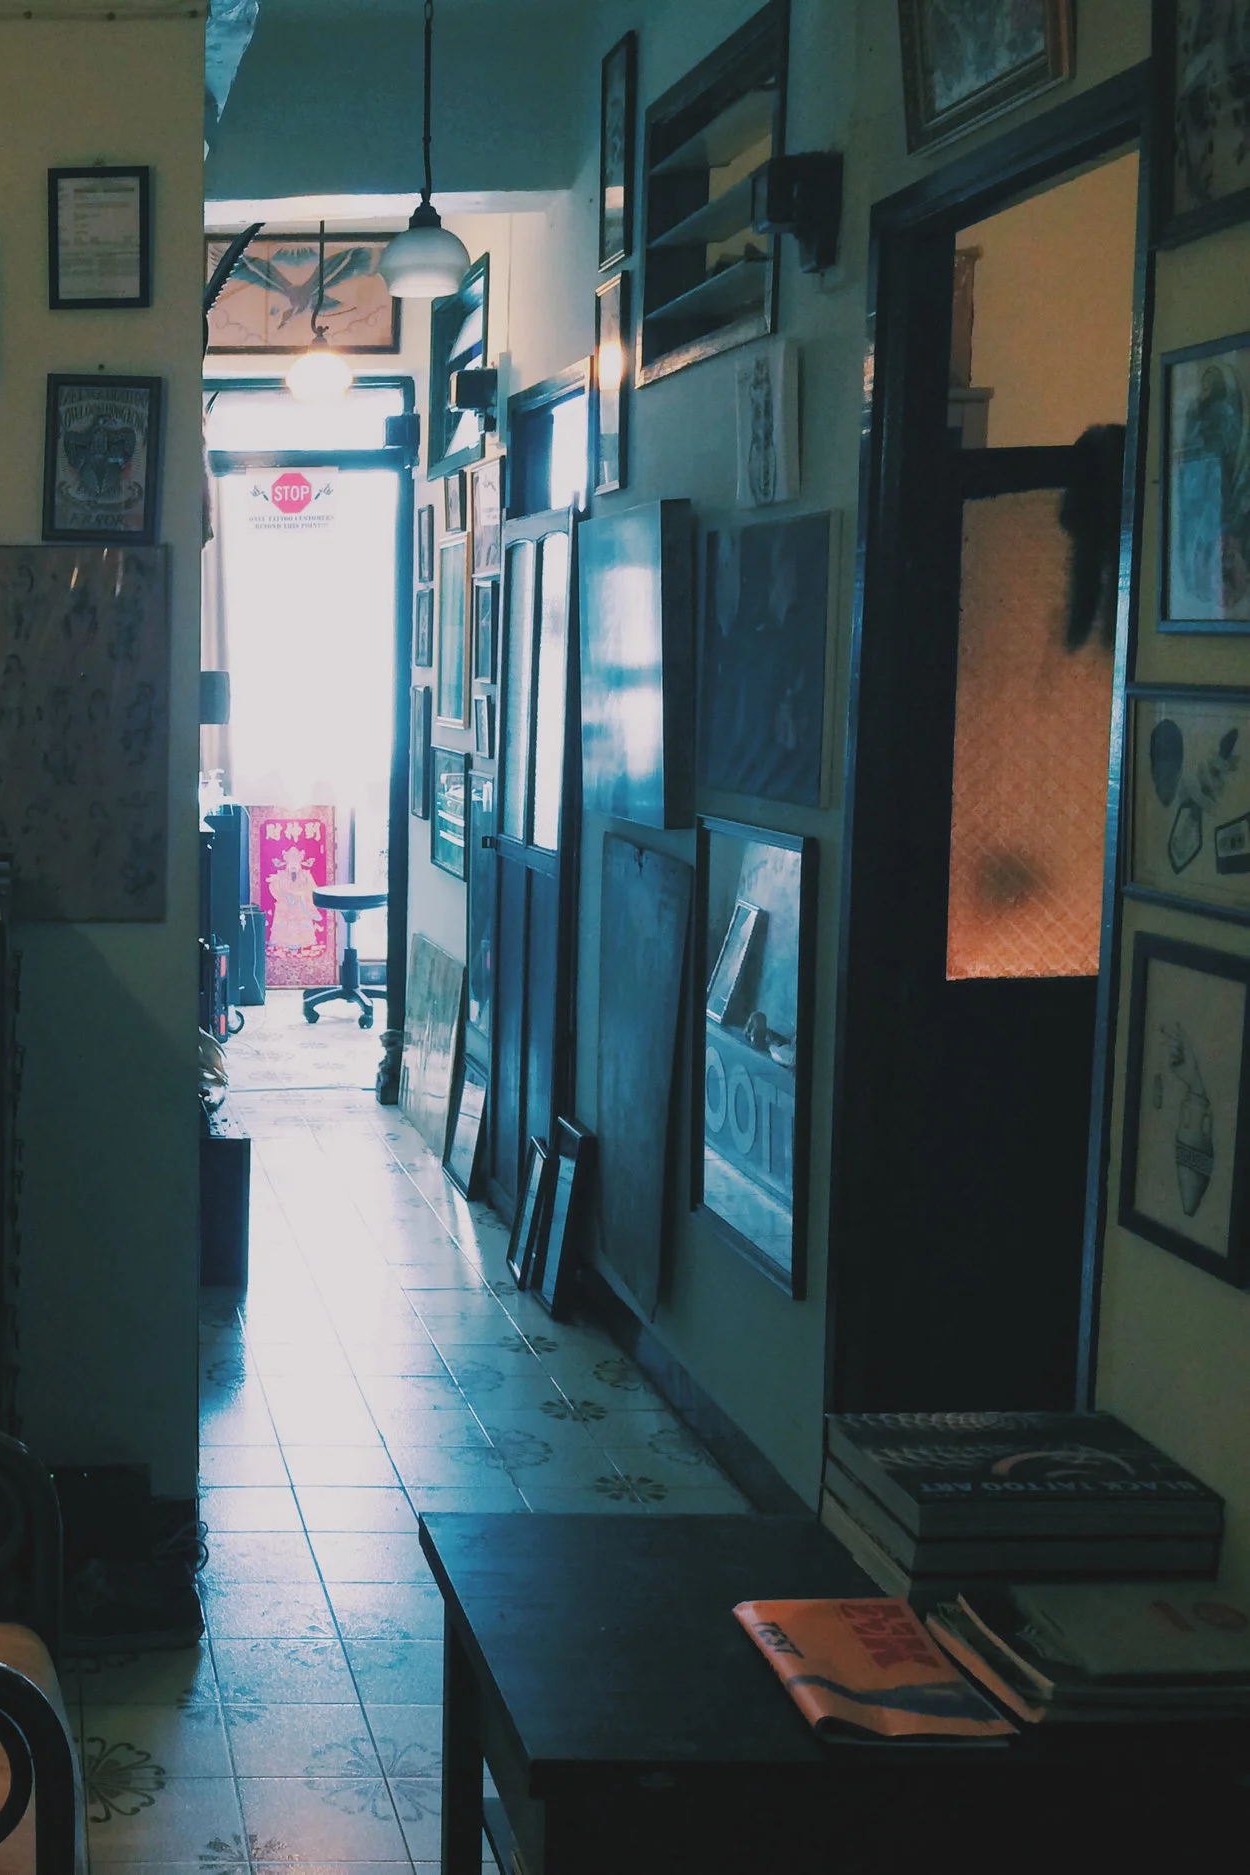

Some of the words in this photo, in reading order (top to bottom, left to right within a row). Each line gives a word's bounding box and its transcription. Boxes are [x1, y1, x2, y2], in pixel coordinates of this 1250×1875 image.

[273, 485, 310, 502] STOP
[920, 1481, 973, 1493] ART
[981, 1481, 1094, 1493] TATTOO
[1098, 1481, 1200, 1493] BLACK
